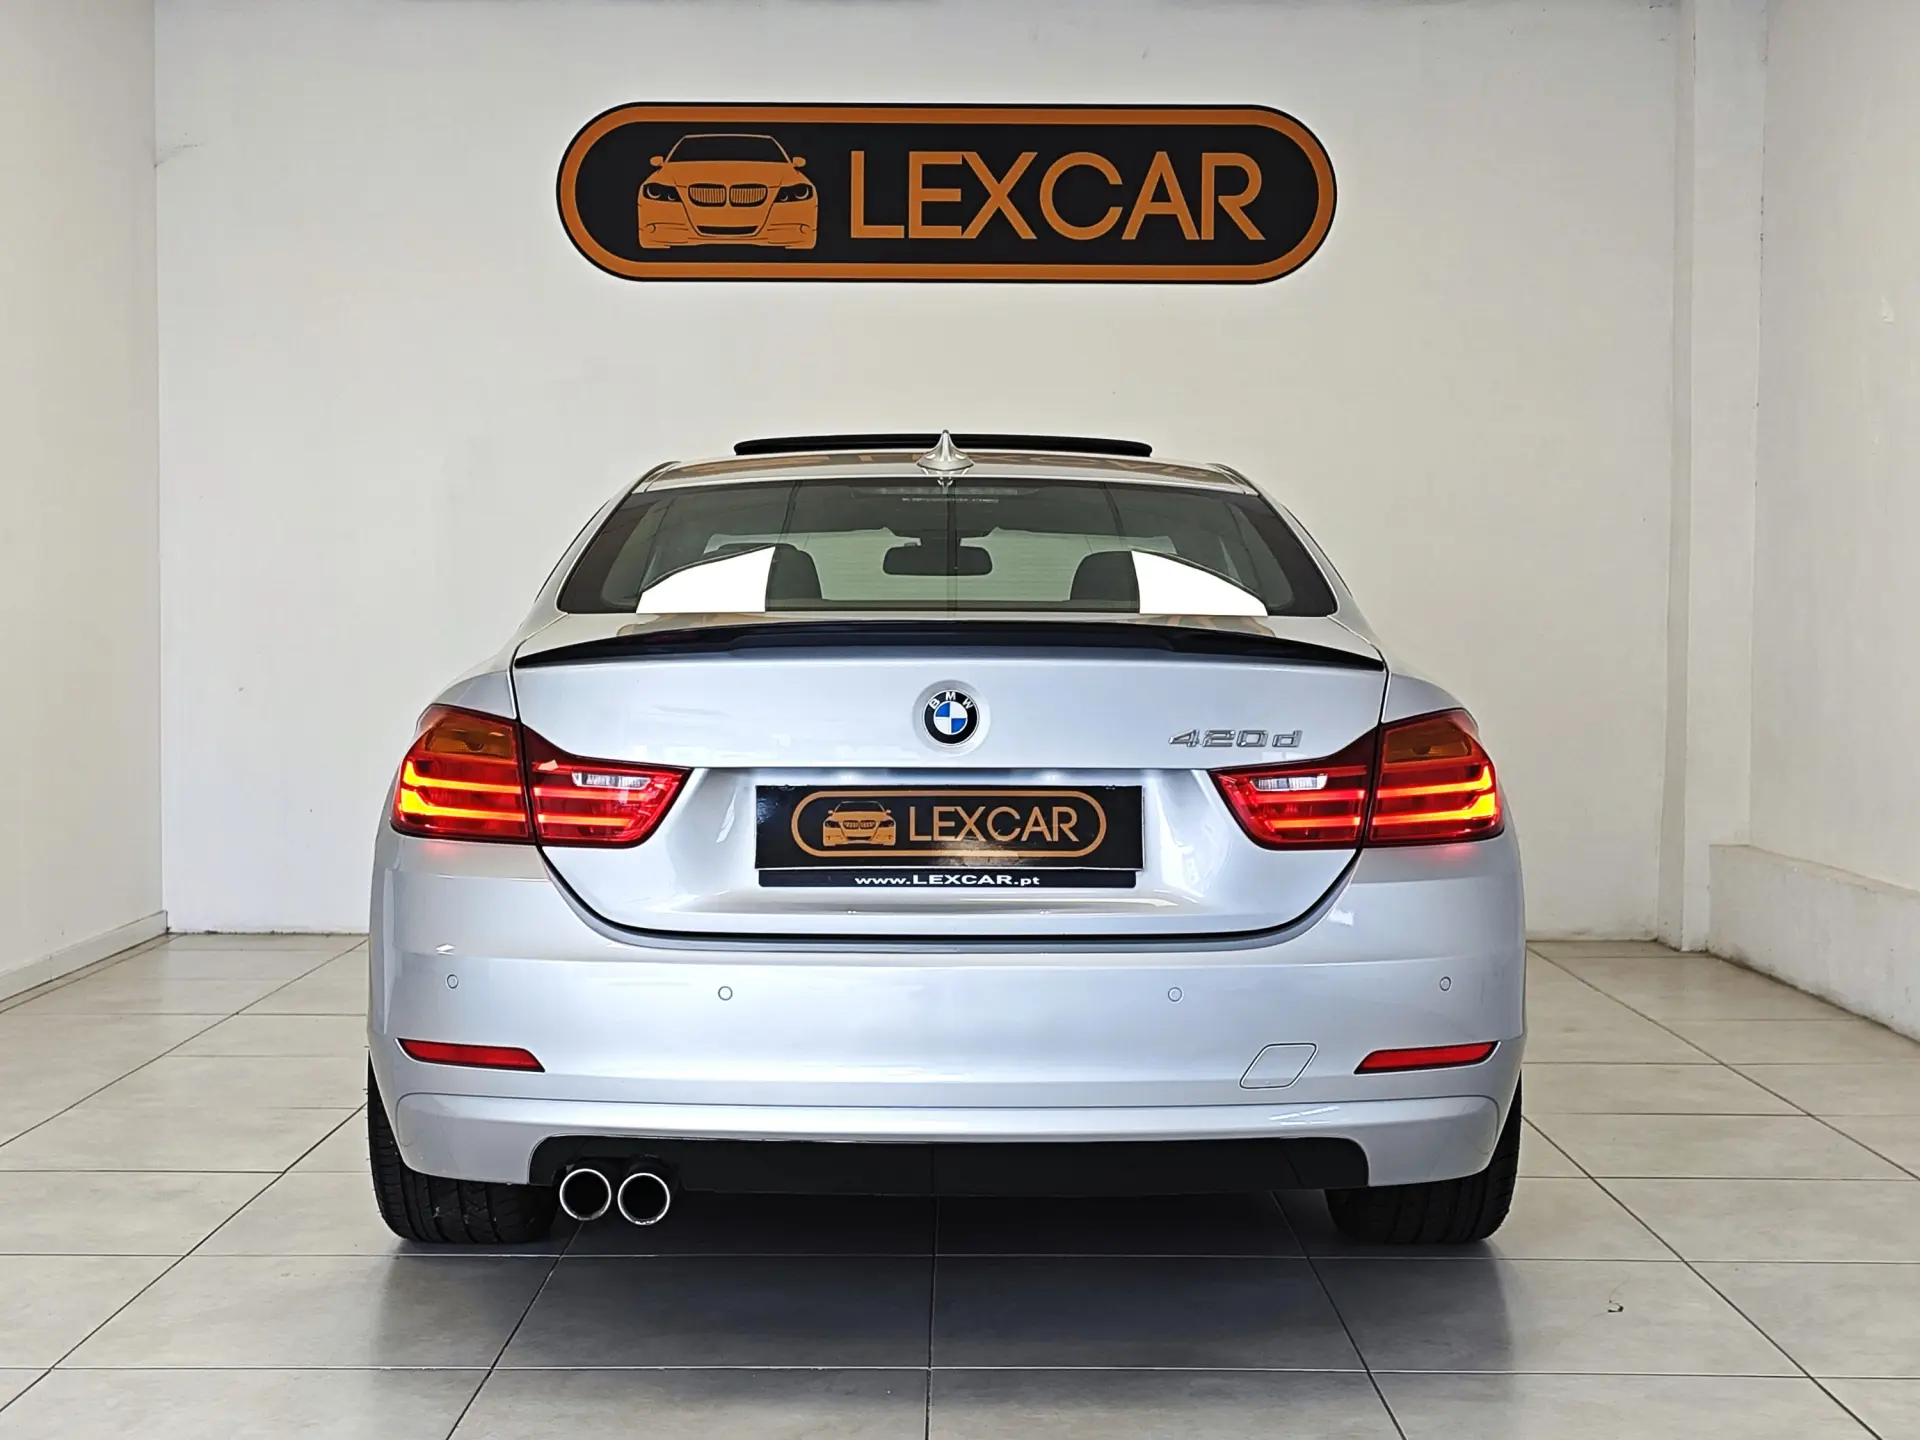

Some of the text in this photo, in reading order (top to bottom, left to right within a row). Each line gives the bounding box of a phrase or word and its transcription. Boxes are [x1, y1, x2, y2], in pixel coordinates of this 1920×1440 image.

[850, 150, 1266, 240] LEXCAR
[928, 691, 974, 709] BMW
[1168, 729, 1303, 748] 420d
[909, 806, 1079, 842] LEXCAR
[855, 874, 1040, 887] www.LEXCAR.pt
